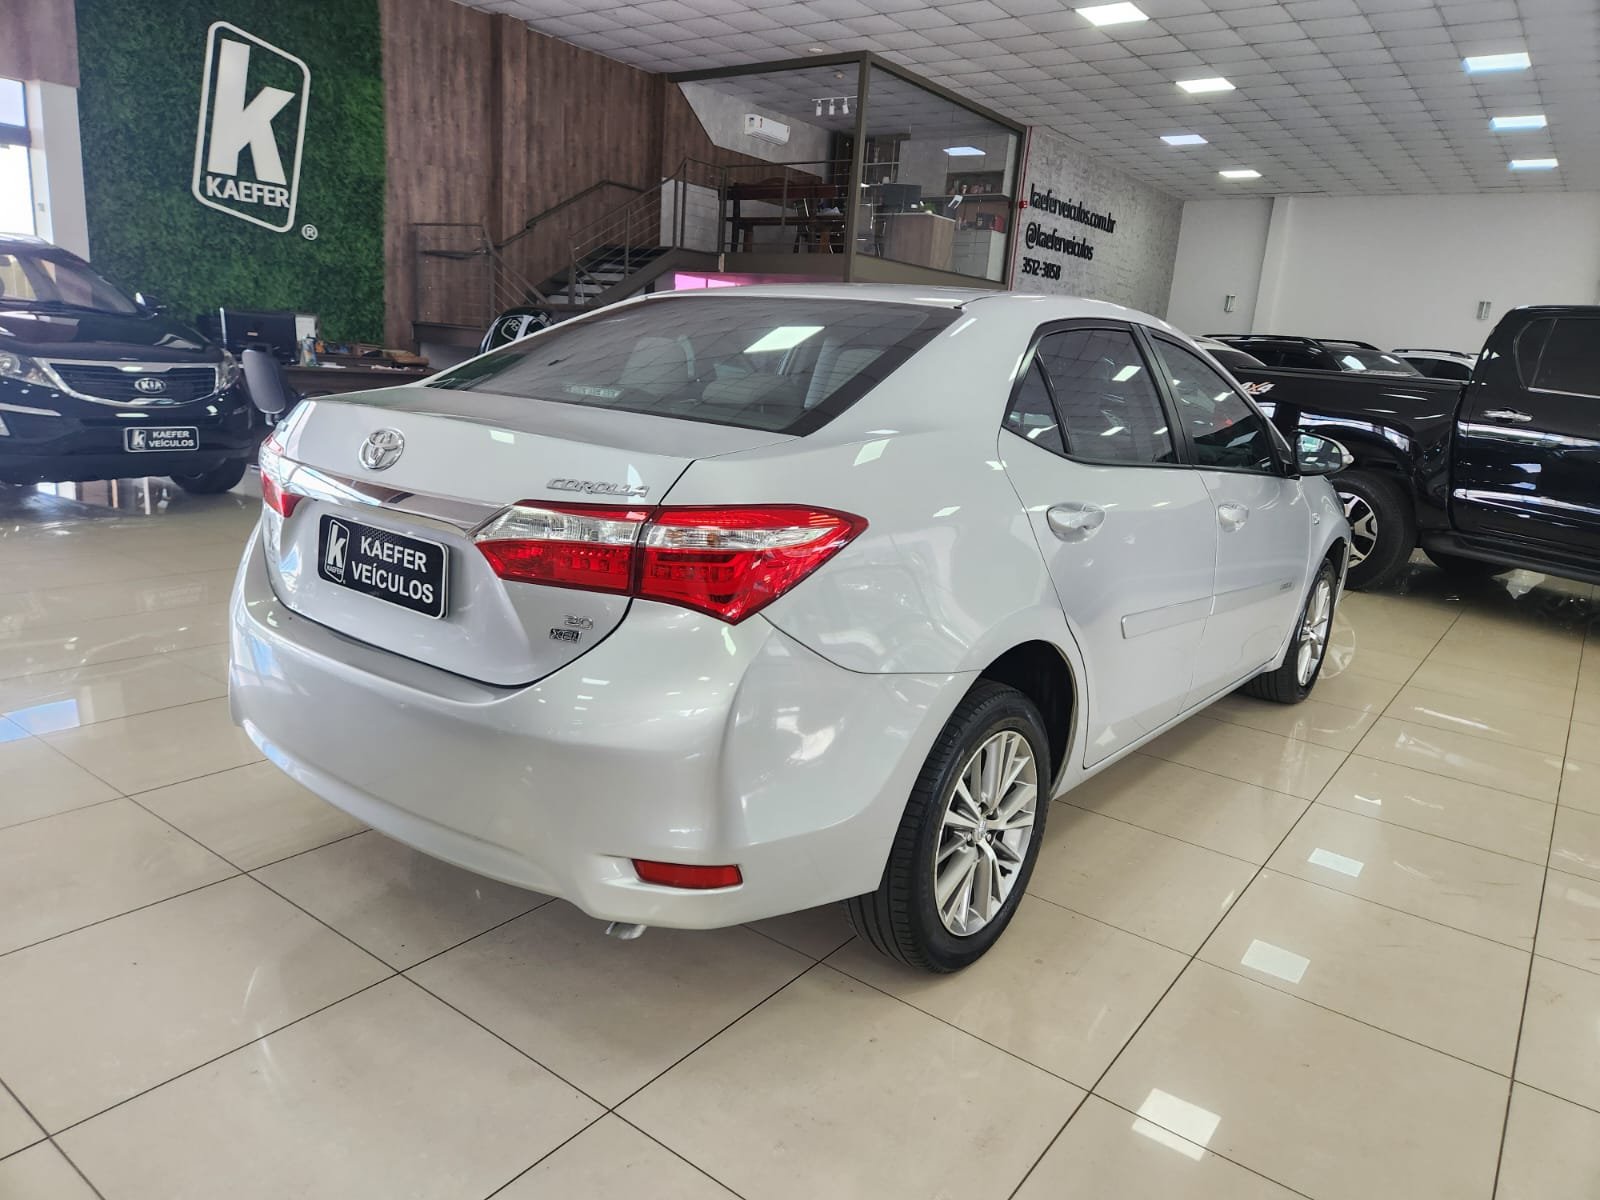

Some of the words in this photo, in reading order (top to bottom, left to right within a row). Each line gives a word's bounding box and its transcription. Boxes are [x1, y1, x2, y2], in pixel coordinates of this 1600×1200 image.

[206, 175, 290, 208] KAEFER
[1029, 183, 1117, 234] kaeferveiculos.com.br
[1025, 222, 1094, 261] @kaeferveiculos
[140, 380, 162, 390] KIA
[148, 438, 195, 448] VEÍCULOS
[152, 430, 190, 438] KAEFER
[546, 479, 649, 498] COROLLA
[361, 535, 427, 573] KAEFER
[351, 561, 434, 604] VEÍCULOS
